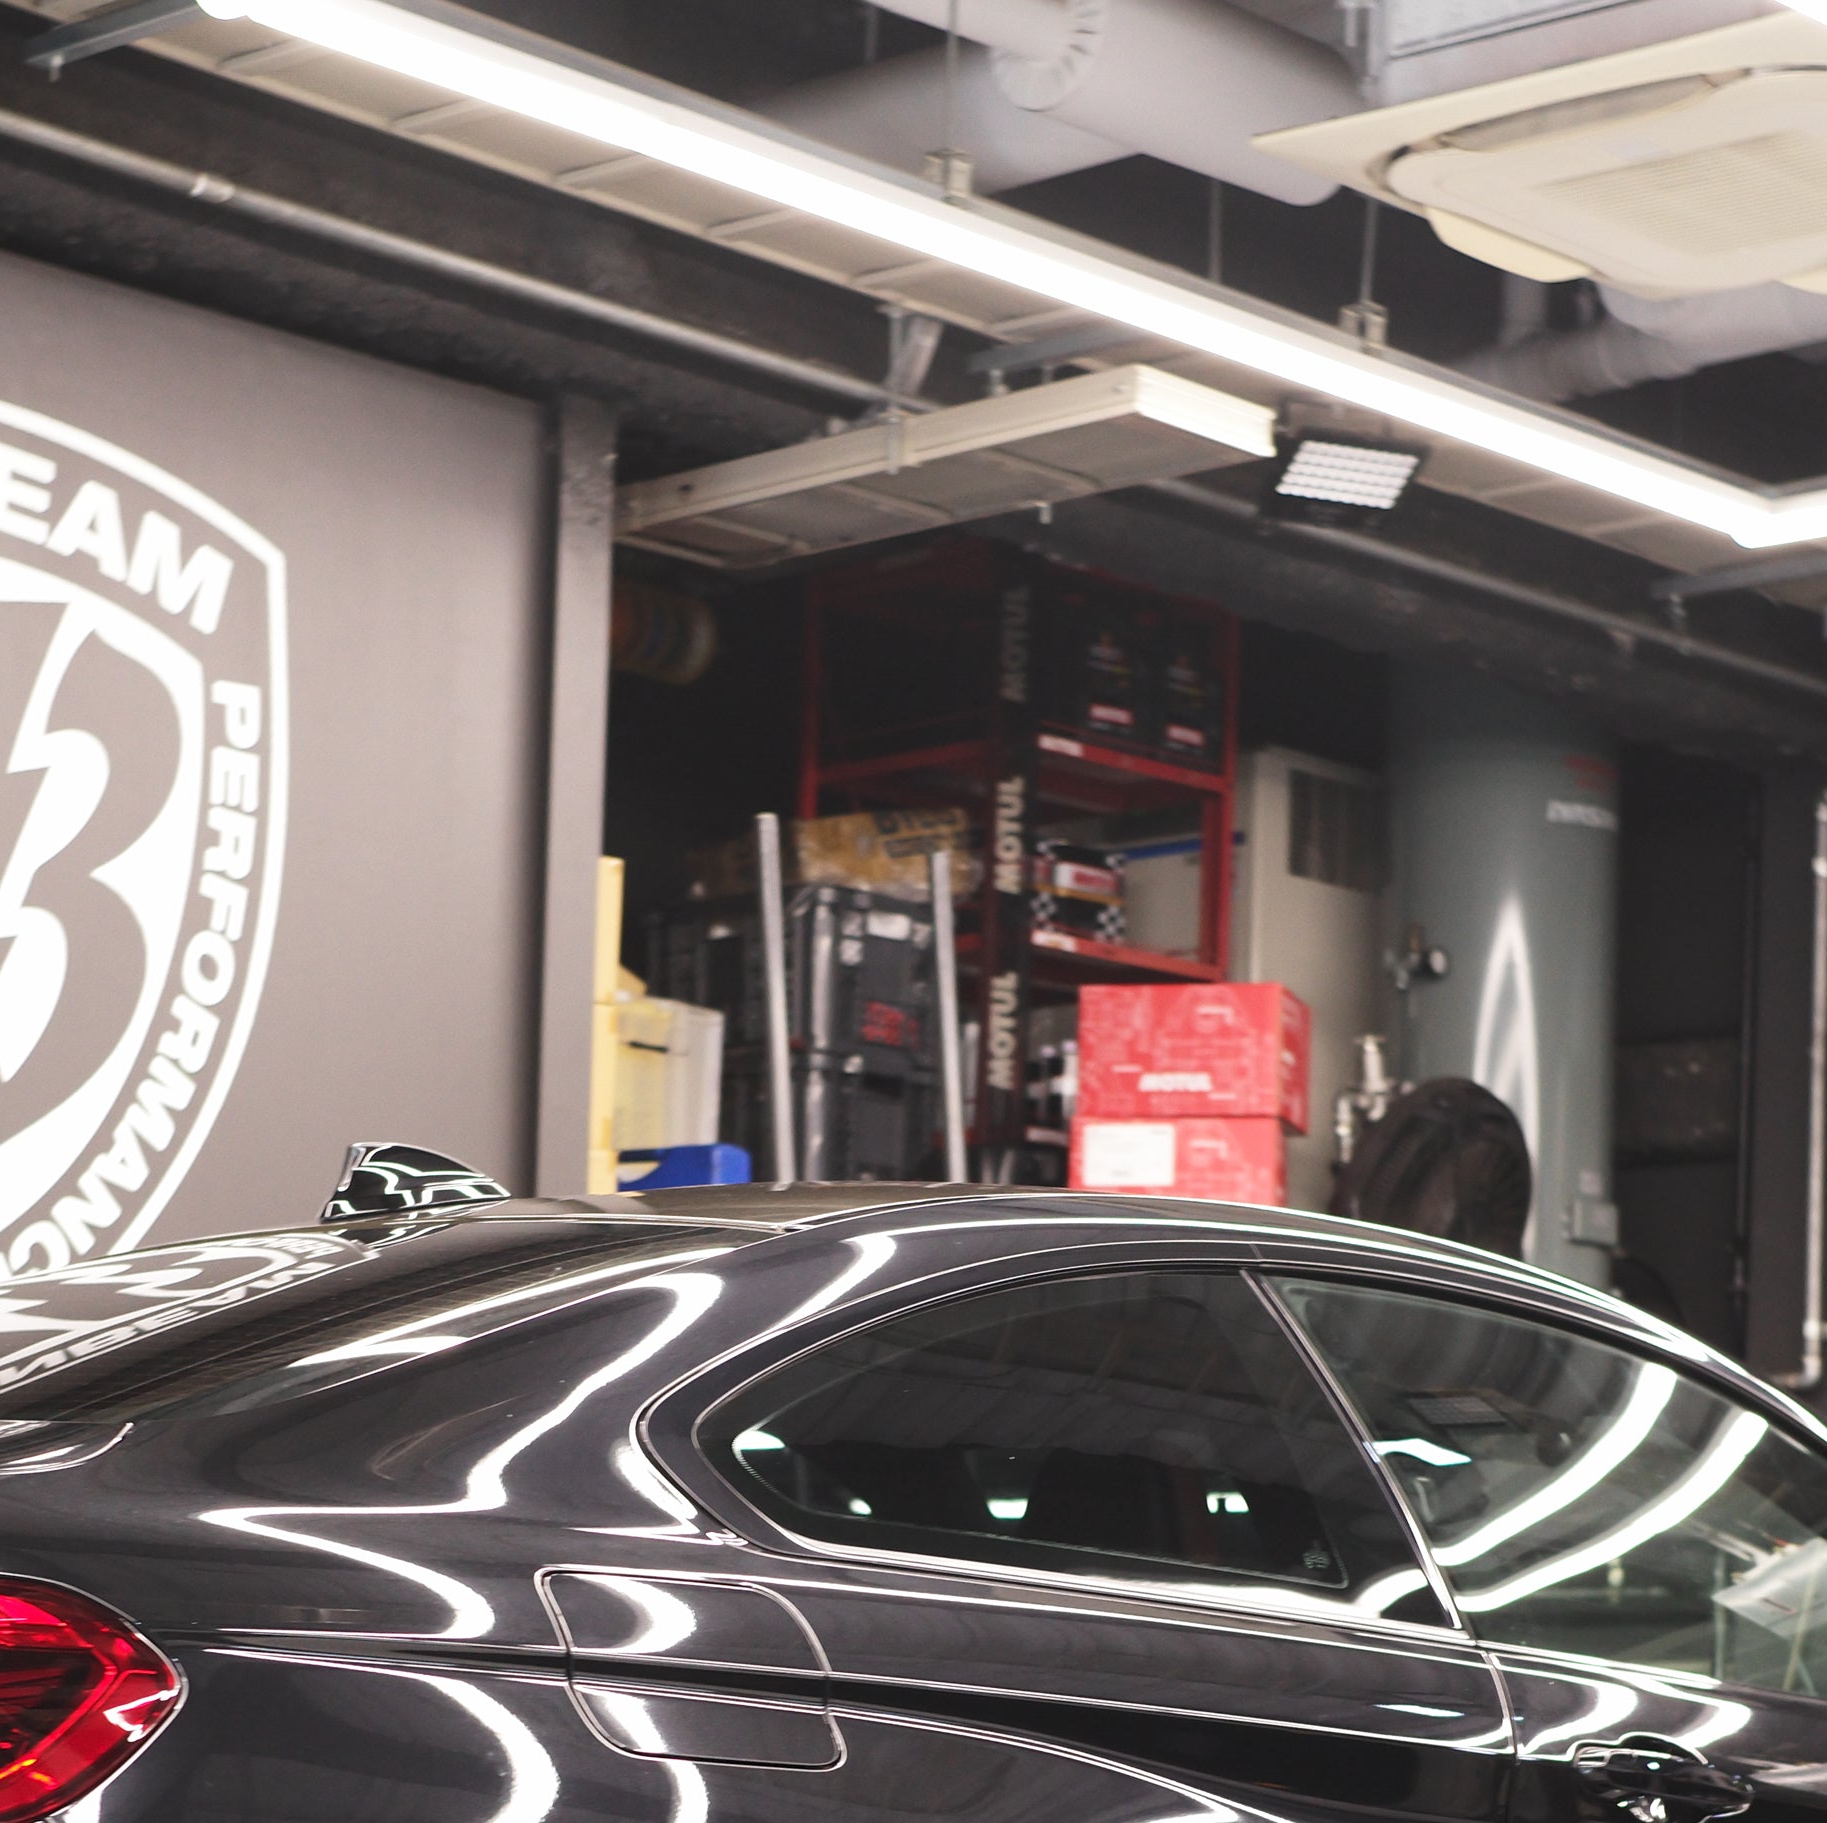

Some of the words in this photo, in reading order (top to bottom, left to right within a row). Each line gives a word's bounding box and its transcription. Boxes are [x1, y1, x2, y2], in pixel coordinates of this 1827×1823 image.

[1000, 586, 1030, 701] MOTUL
[994, 775, 1025, 894] MOTUL
[988, 971, 1019, 1090] MOTUL
